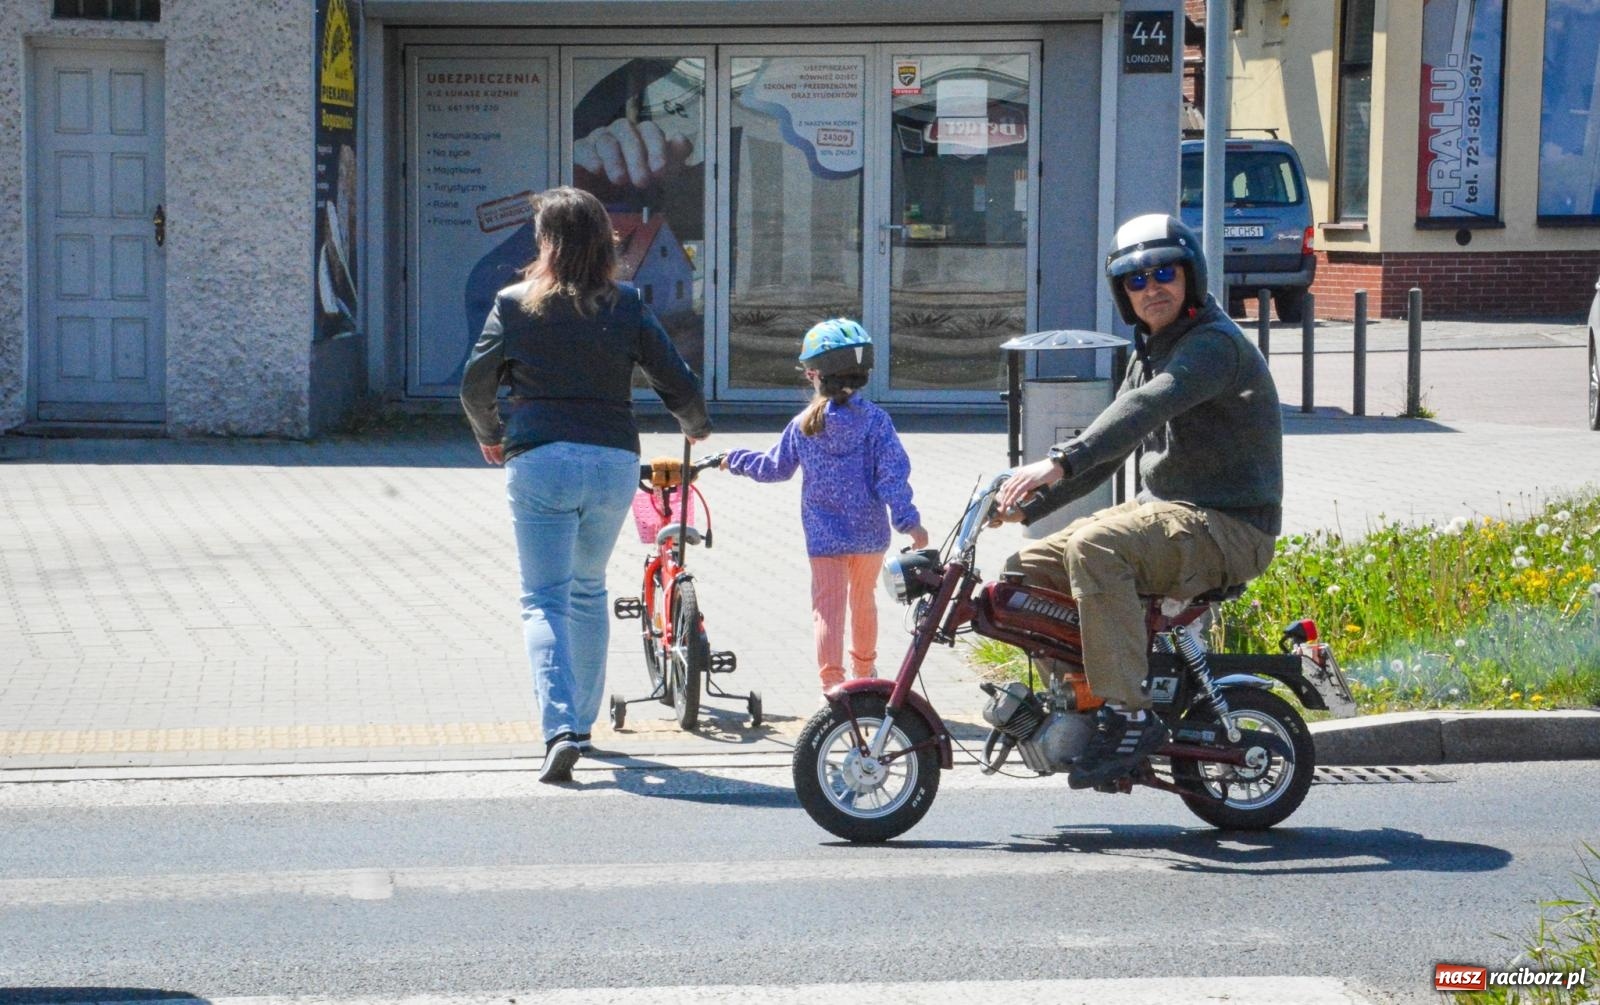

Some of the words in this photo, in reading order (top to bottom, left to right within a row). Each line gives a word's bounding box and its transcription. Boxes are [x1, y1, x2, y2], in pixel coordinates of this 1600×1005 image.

[1132, 21, 1167, 46] 44
[1126, 54, 1170, 64] LONDZINA
[427, 73, 540, 84] UBEZPIECZENIA
[1466, 54, 1483, 167] 721-821-947
[434, 183, 487, 194] Turystyczne
[1465, 174, 1479, 204] tel.
